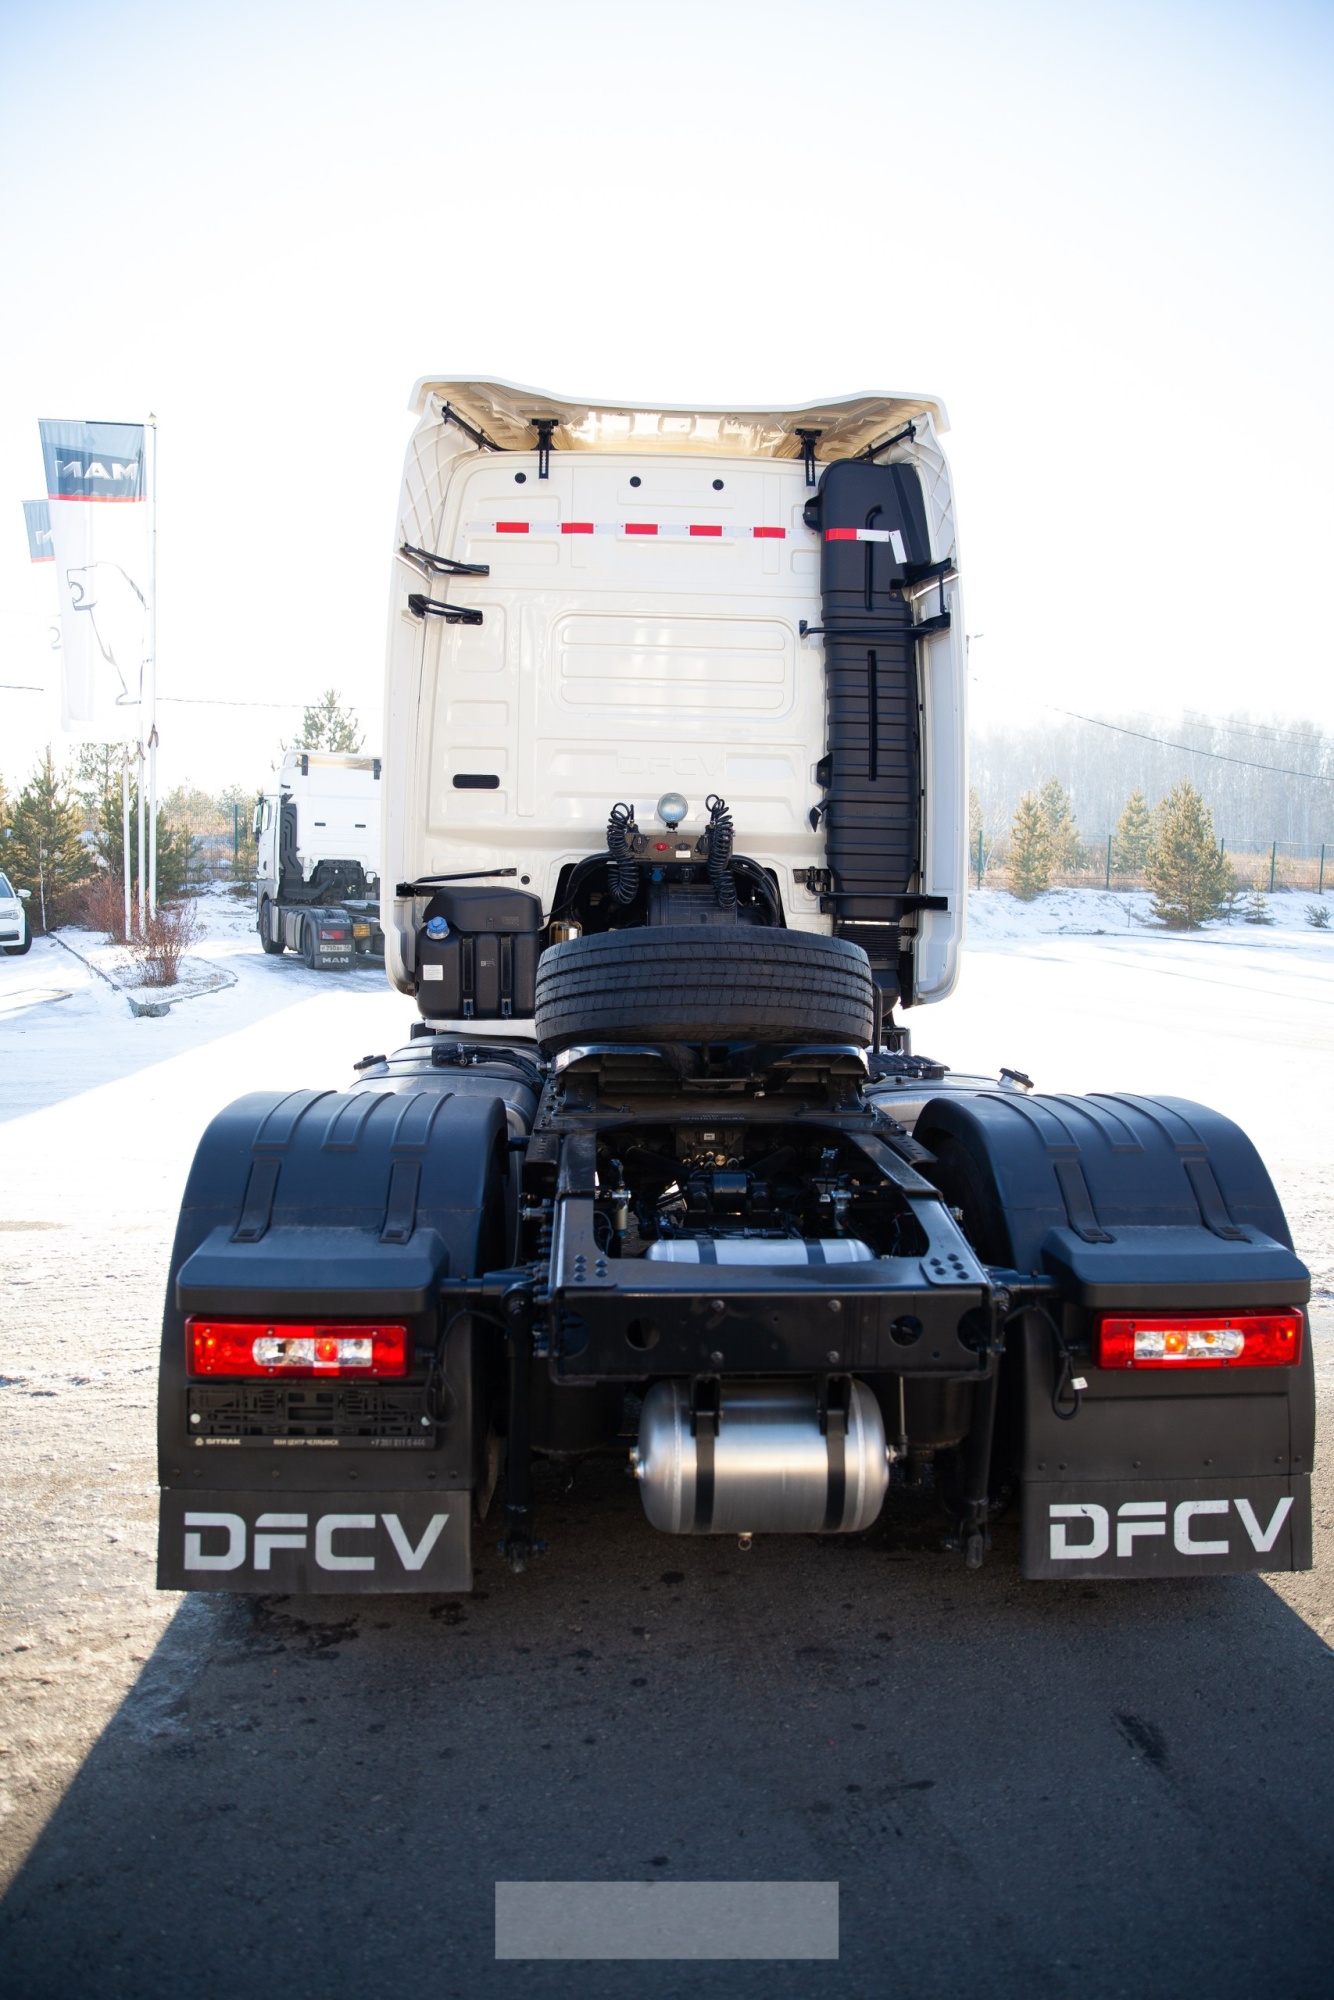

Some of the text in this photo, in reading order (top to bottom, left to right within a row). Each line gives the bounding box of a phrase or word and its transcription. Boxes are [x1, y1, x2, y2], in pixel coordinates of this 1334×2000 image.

[618, 753, 722, 776] DFCV
[183, 1511, 450, 1571] DFCV
[1049, 1496, 1295, 1560] DFCV
